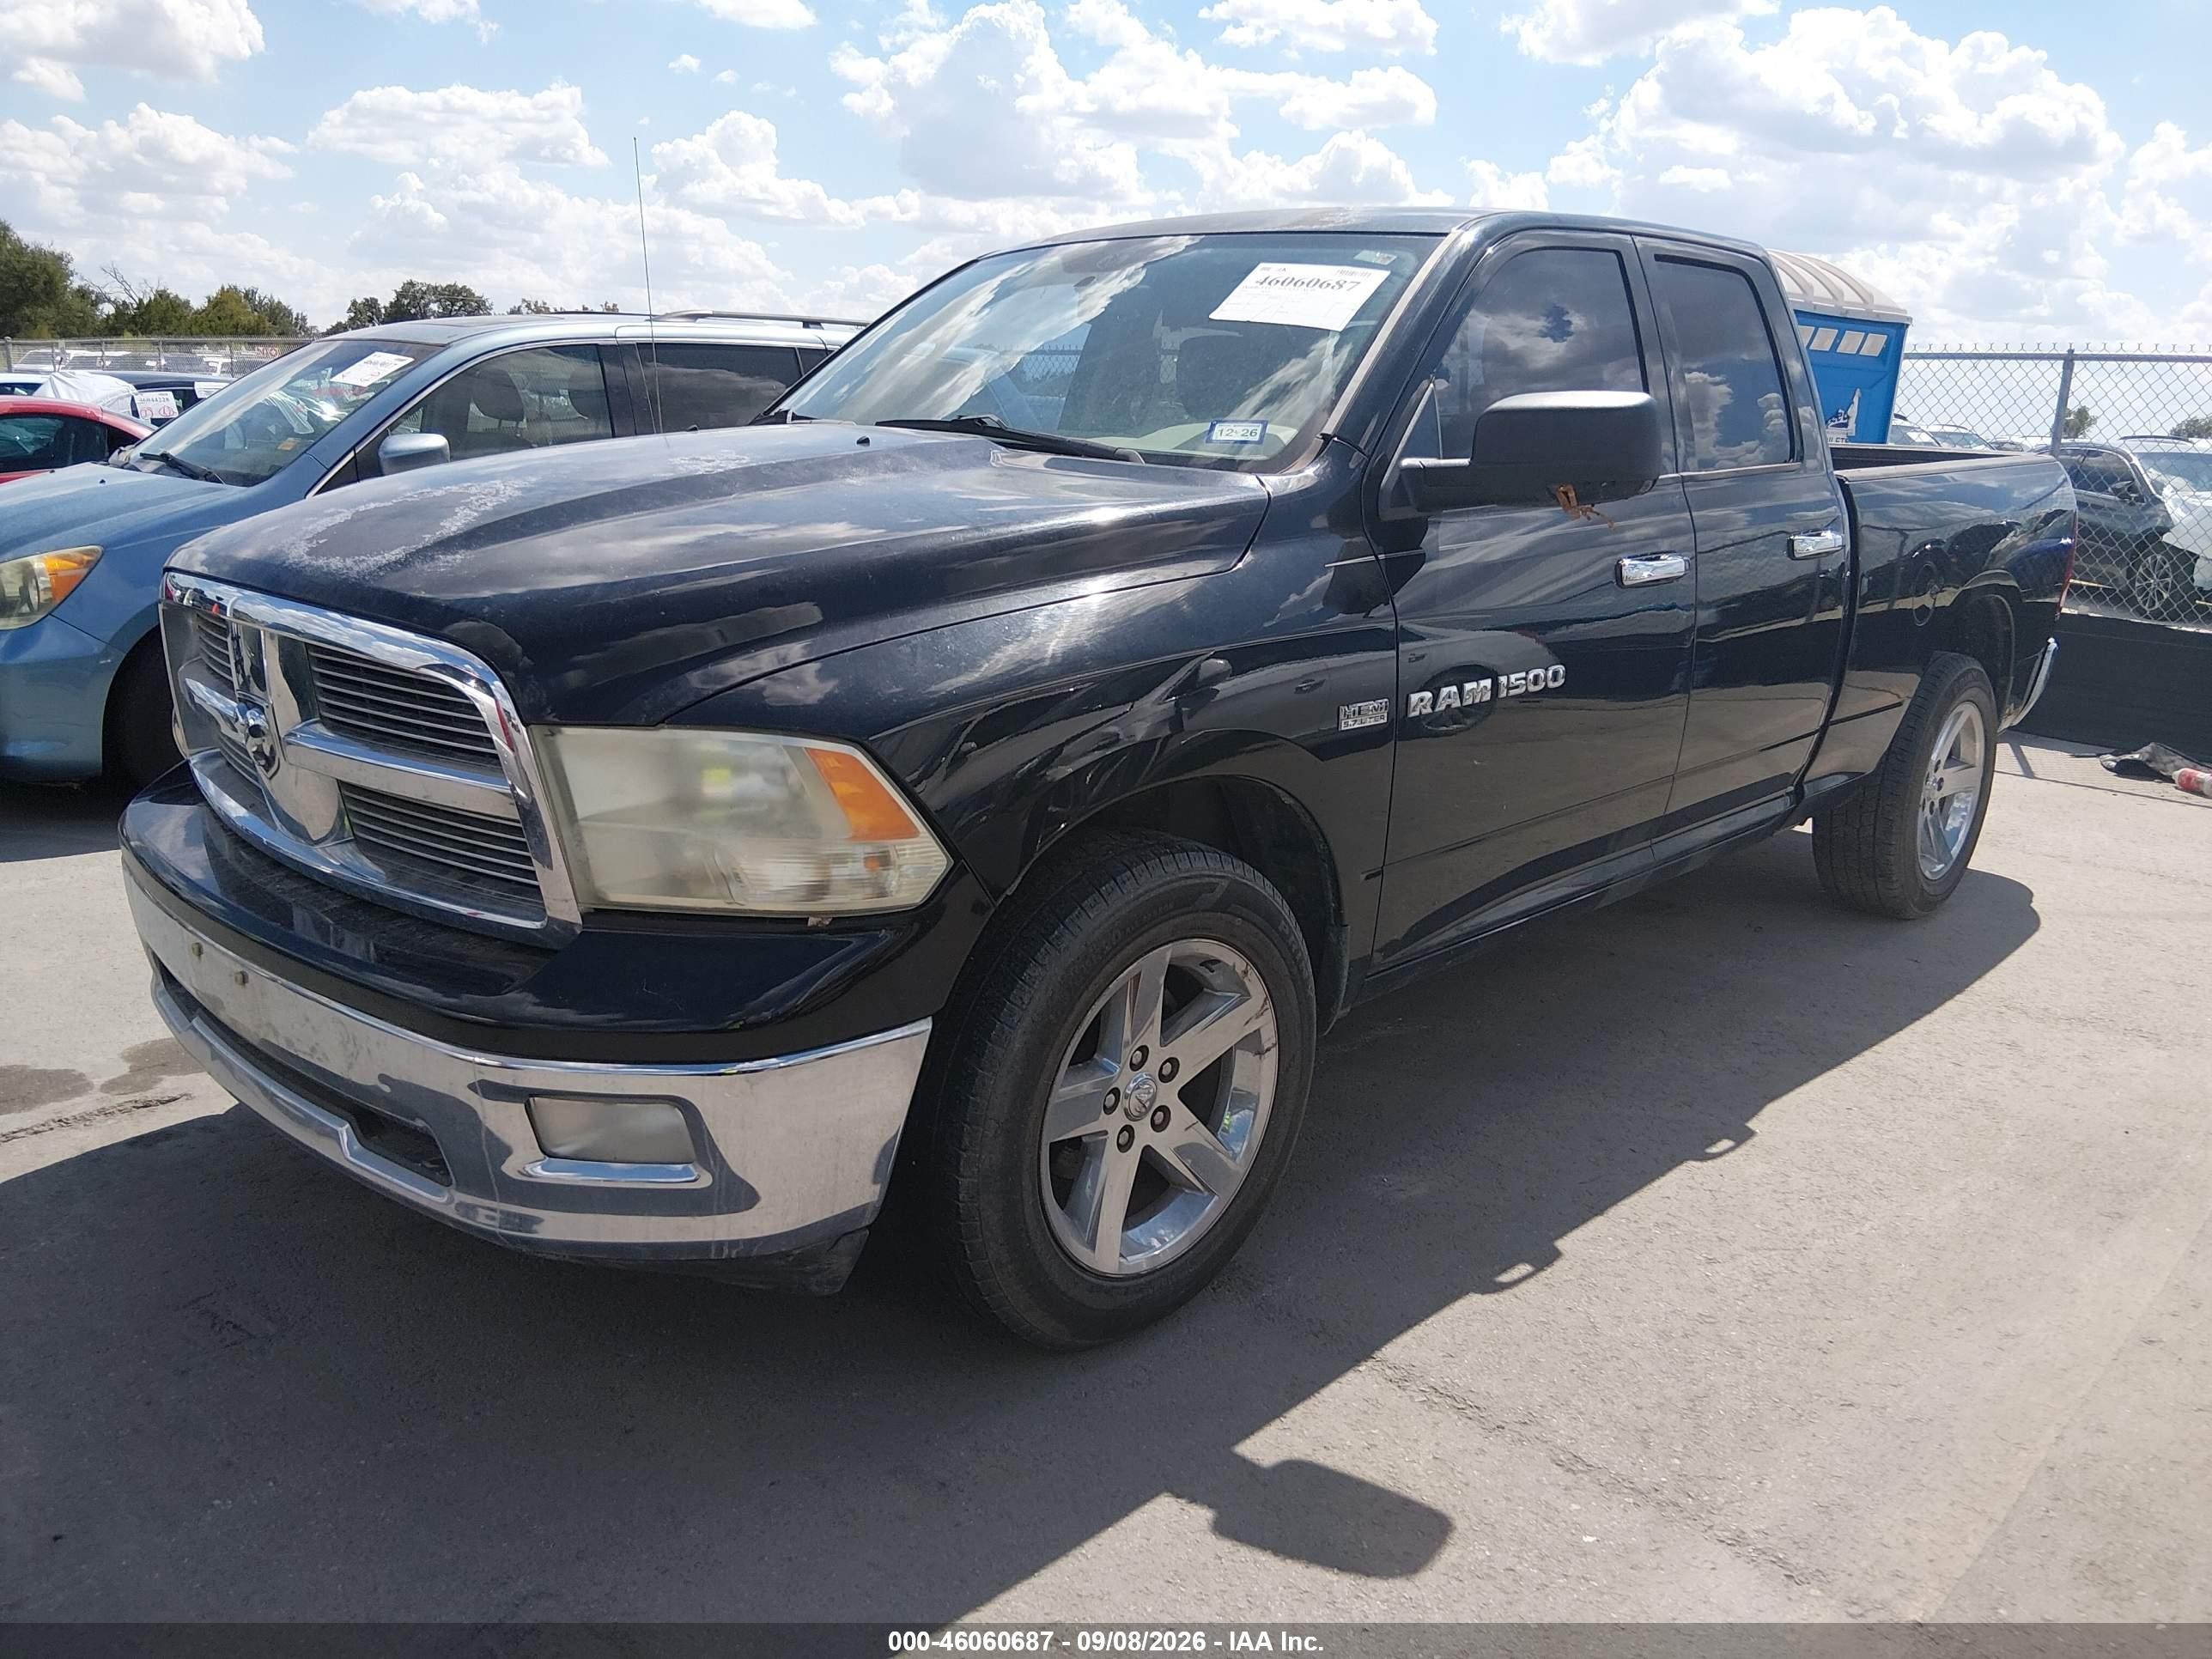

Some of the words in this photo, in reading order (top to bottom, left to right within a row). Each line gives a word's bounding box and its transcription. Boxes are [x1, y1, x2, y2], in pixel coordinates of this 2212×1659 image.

[1255, 275, 1361, 292] 46060687
[1407, 677, 1492, 718] RAM
[1497, 664, 1566, 699] 1500
